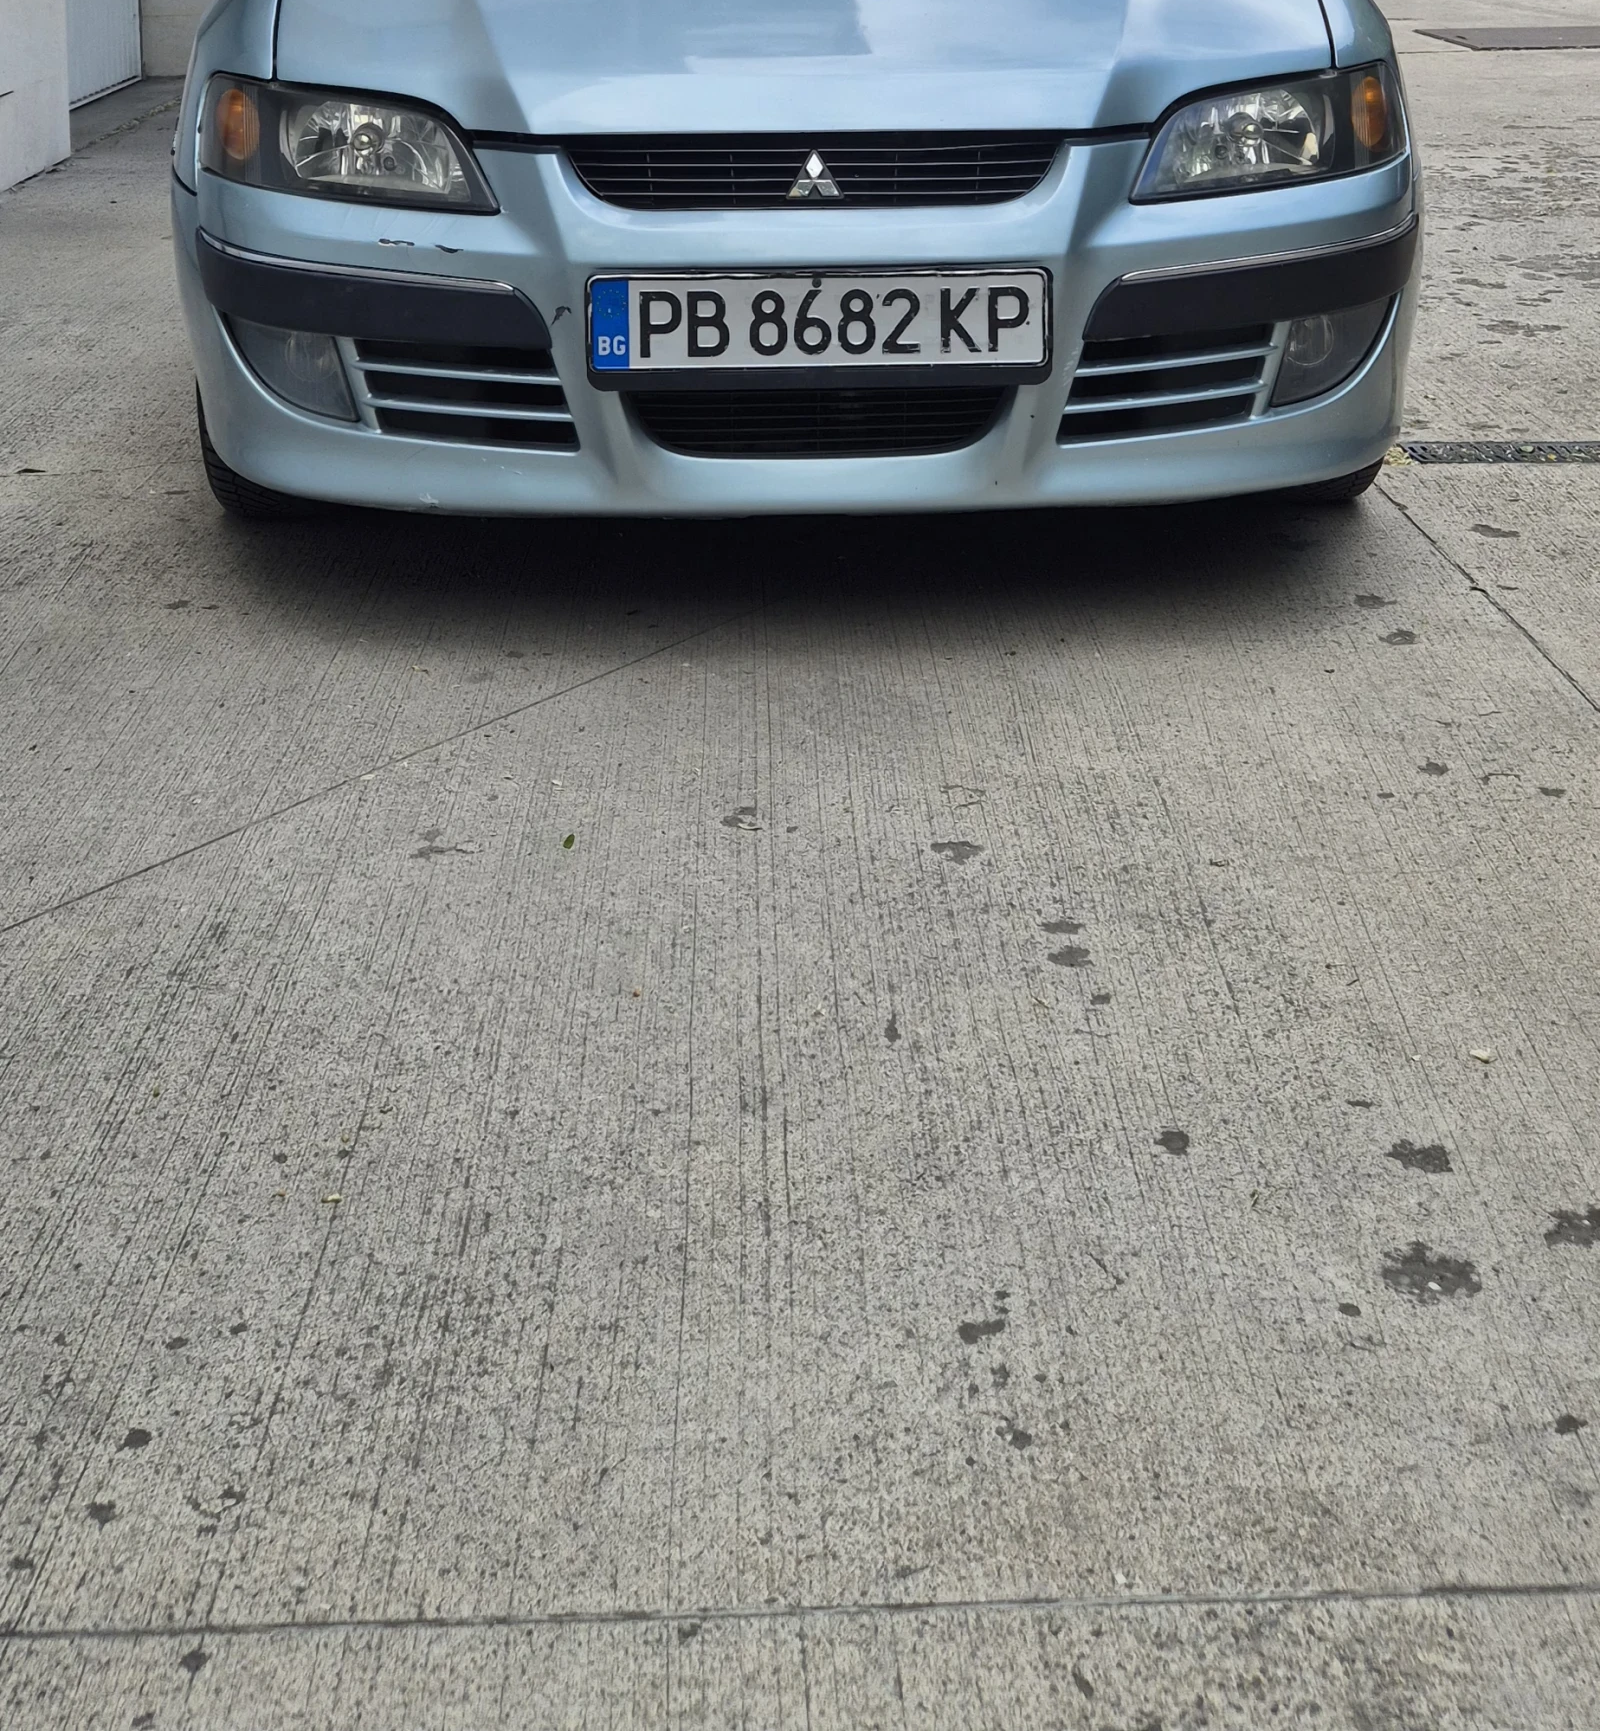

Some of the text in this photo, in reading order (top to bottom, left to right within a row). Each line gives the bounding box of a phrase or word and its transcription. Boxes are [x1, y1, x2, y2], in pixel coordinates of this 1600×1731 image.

[638, 286, 1031, 358] PB 8682 KP
[597, 336, 627, 357] BG
